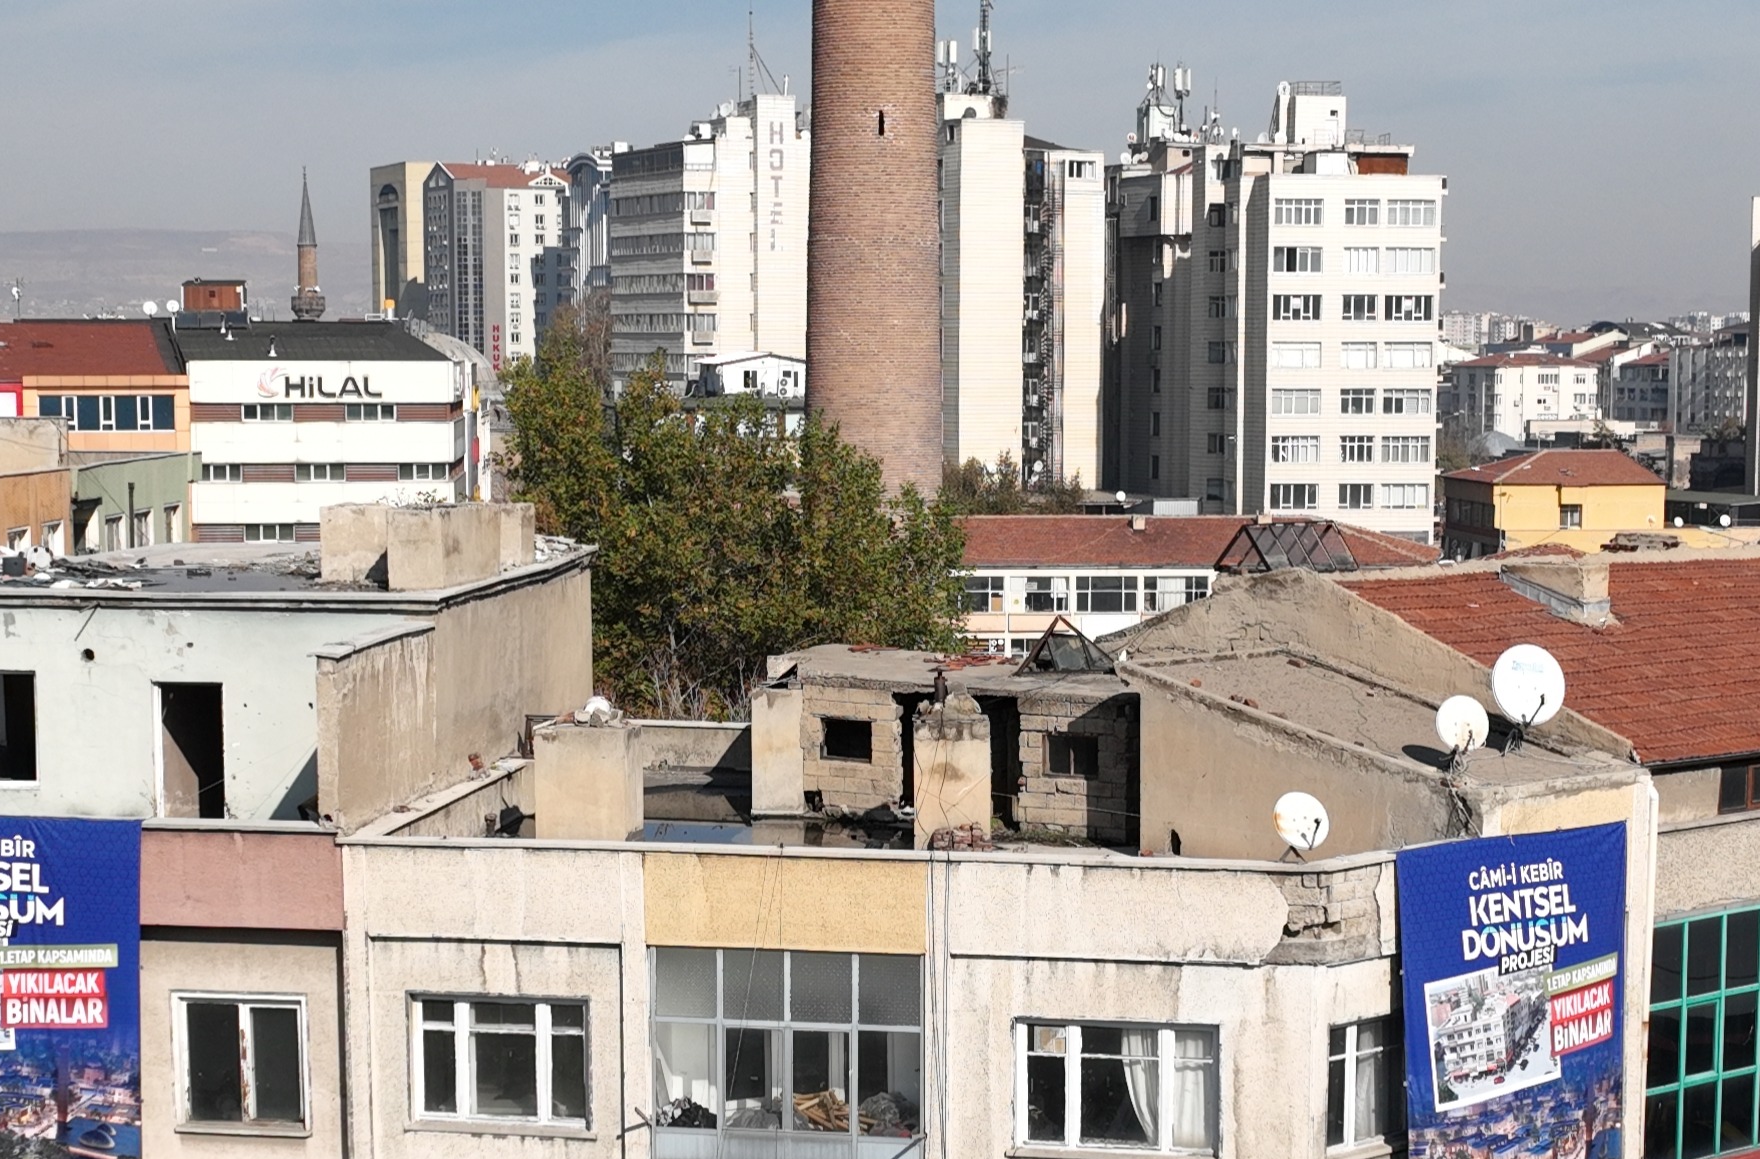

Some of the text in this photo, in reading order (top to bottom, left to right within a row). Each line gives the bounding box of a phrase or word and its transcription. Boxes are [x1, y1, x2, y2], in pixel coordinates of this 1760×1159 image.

[1468, 883, 1577, 927] KENTSEL
[37, 950, 113, 965] KAPSAMINDA
[1572, 957, 1617, 984] KAPSAMINDA
[8, 972, 100, 994] YIKILACAK
[1554, 984, 1610, 1021] YIKILACAK
